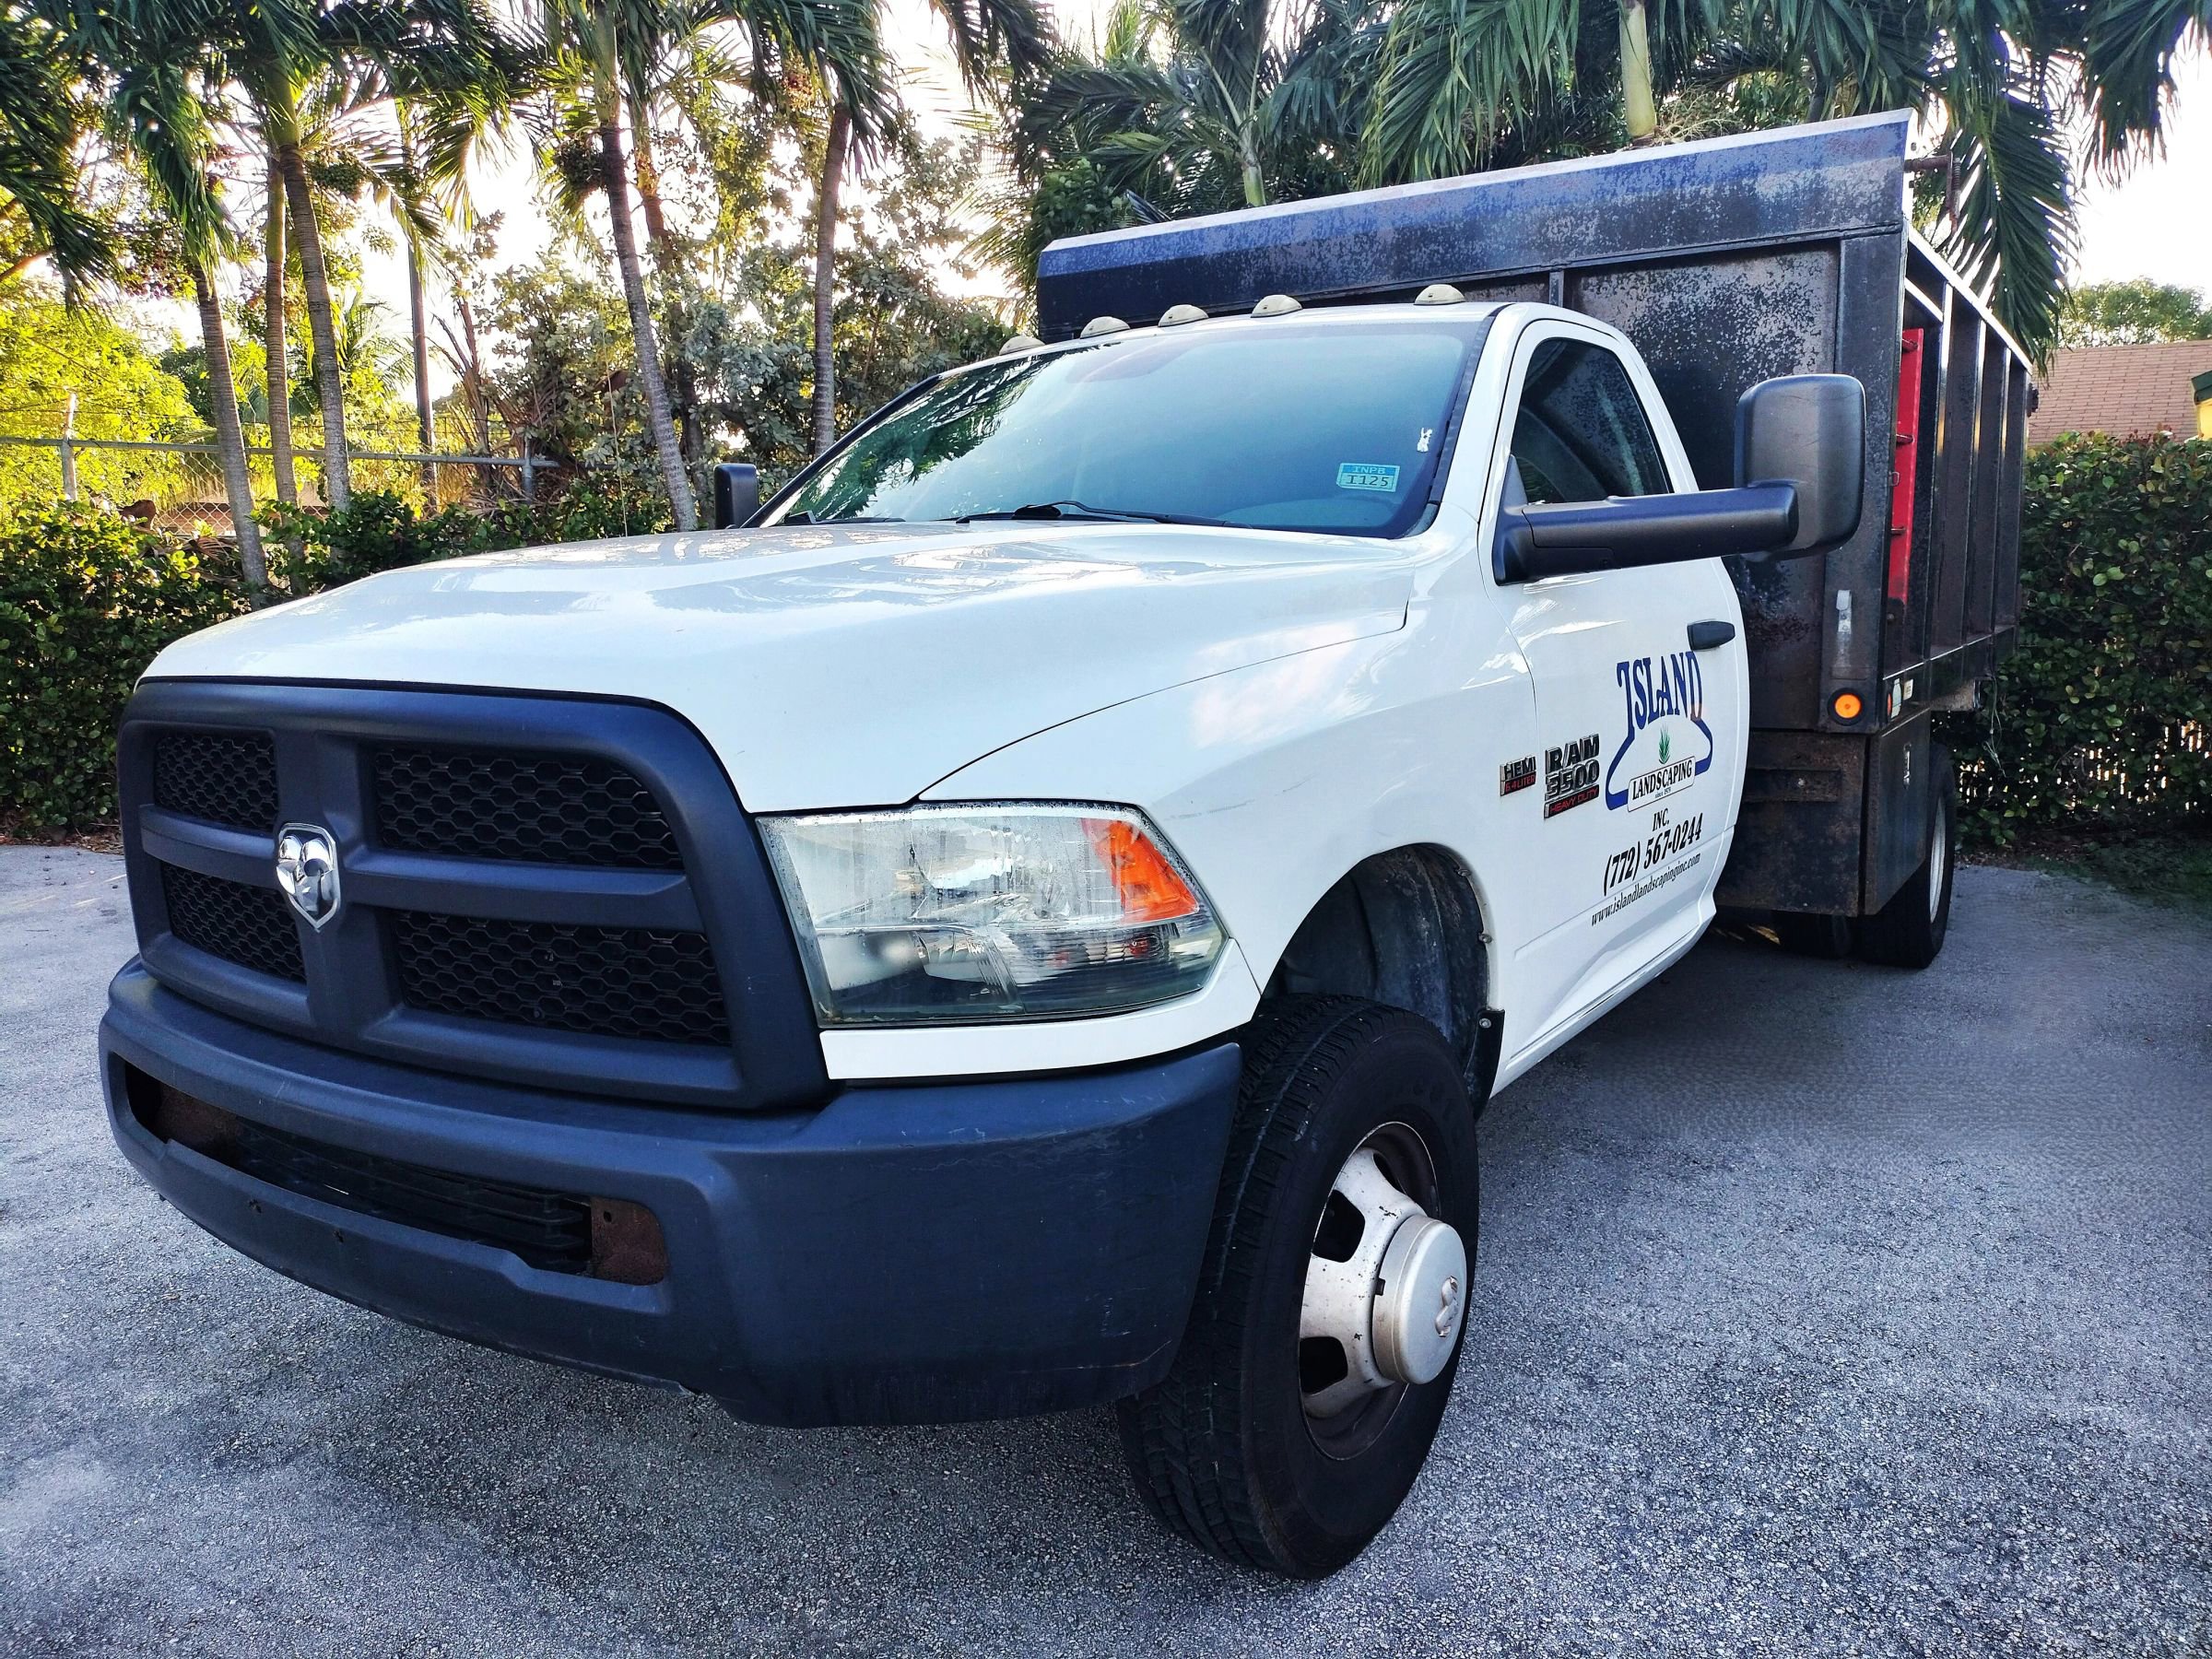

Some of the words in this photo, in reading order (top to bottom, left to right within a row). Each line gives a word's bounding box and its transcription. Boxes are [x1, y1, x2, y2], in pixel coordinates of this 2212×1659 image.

[1617, 651, 1703, 736] ISLAND
[1500, 755, 1536, 782] HEMI
[1545, 734, 1599, 775] RAM
[1545, 759, 1600, 801] 3500
[1550, 796, 1576, 812] HEAVY
[1577, 788, 1598, 803] DUTY
[1632, 759, 1692, 800] LANDSCAPING
[1652, 807, 1669, 831] INC.
[1604, 841, 1641, 897] (772)
[1643, 812, 1703, 869] 567-0244
[1591, 853, 1701, 926] www.islandlandscapinginc.com
